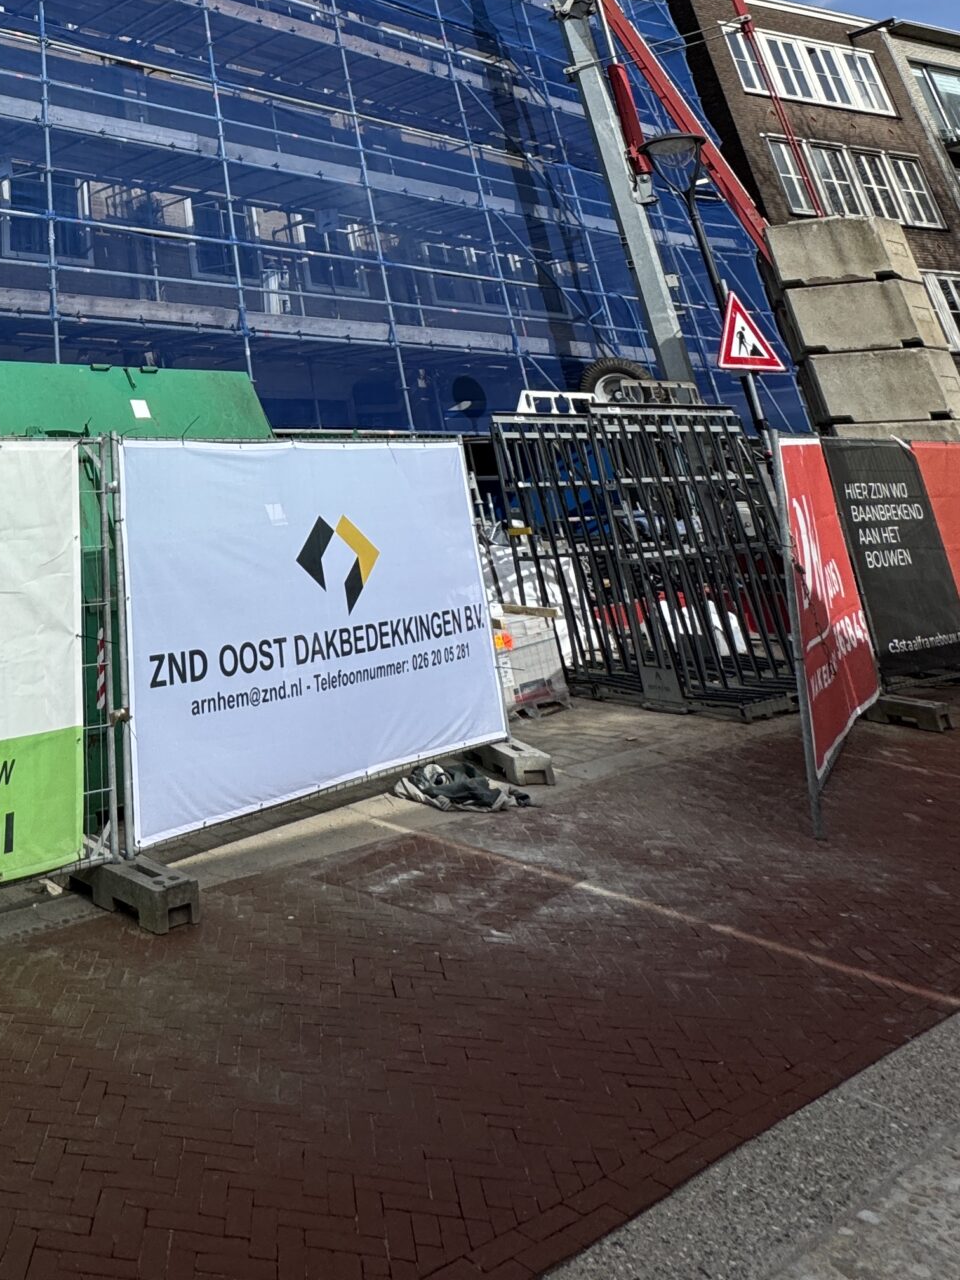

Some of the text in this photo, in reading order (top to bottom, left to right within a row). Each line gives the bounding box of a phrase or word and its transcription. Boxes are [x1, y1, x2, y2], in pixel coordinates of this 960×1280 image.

[844, 483, 868, 500] HIER
[851, 503, 924, 522] BAANBREKEND
[858, 526, 901, 545] AAN HET
[864, 548, 912, 569] BOUWEN
[149, 603, 485, 688] ZND OOST DAKBEDEKKINGEN B.V.
[191, 678, 303, 716] arnhem@znd.nl
[313, 659, 409, 693] Telefoonnummer:
[411, 650, 429, 671] 026
[431, 648, 442, 667] 20
[444, 645, 455, 664] 05
[456, 642, 470, 661] 281
